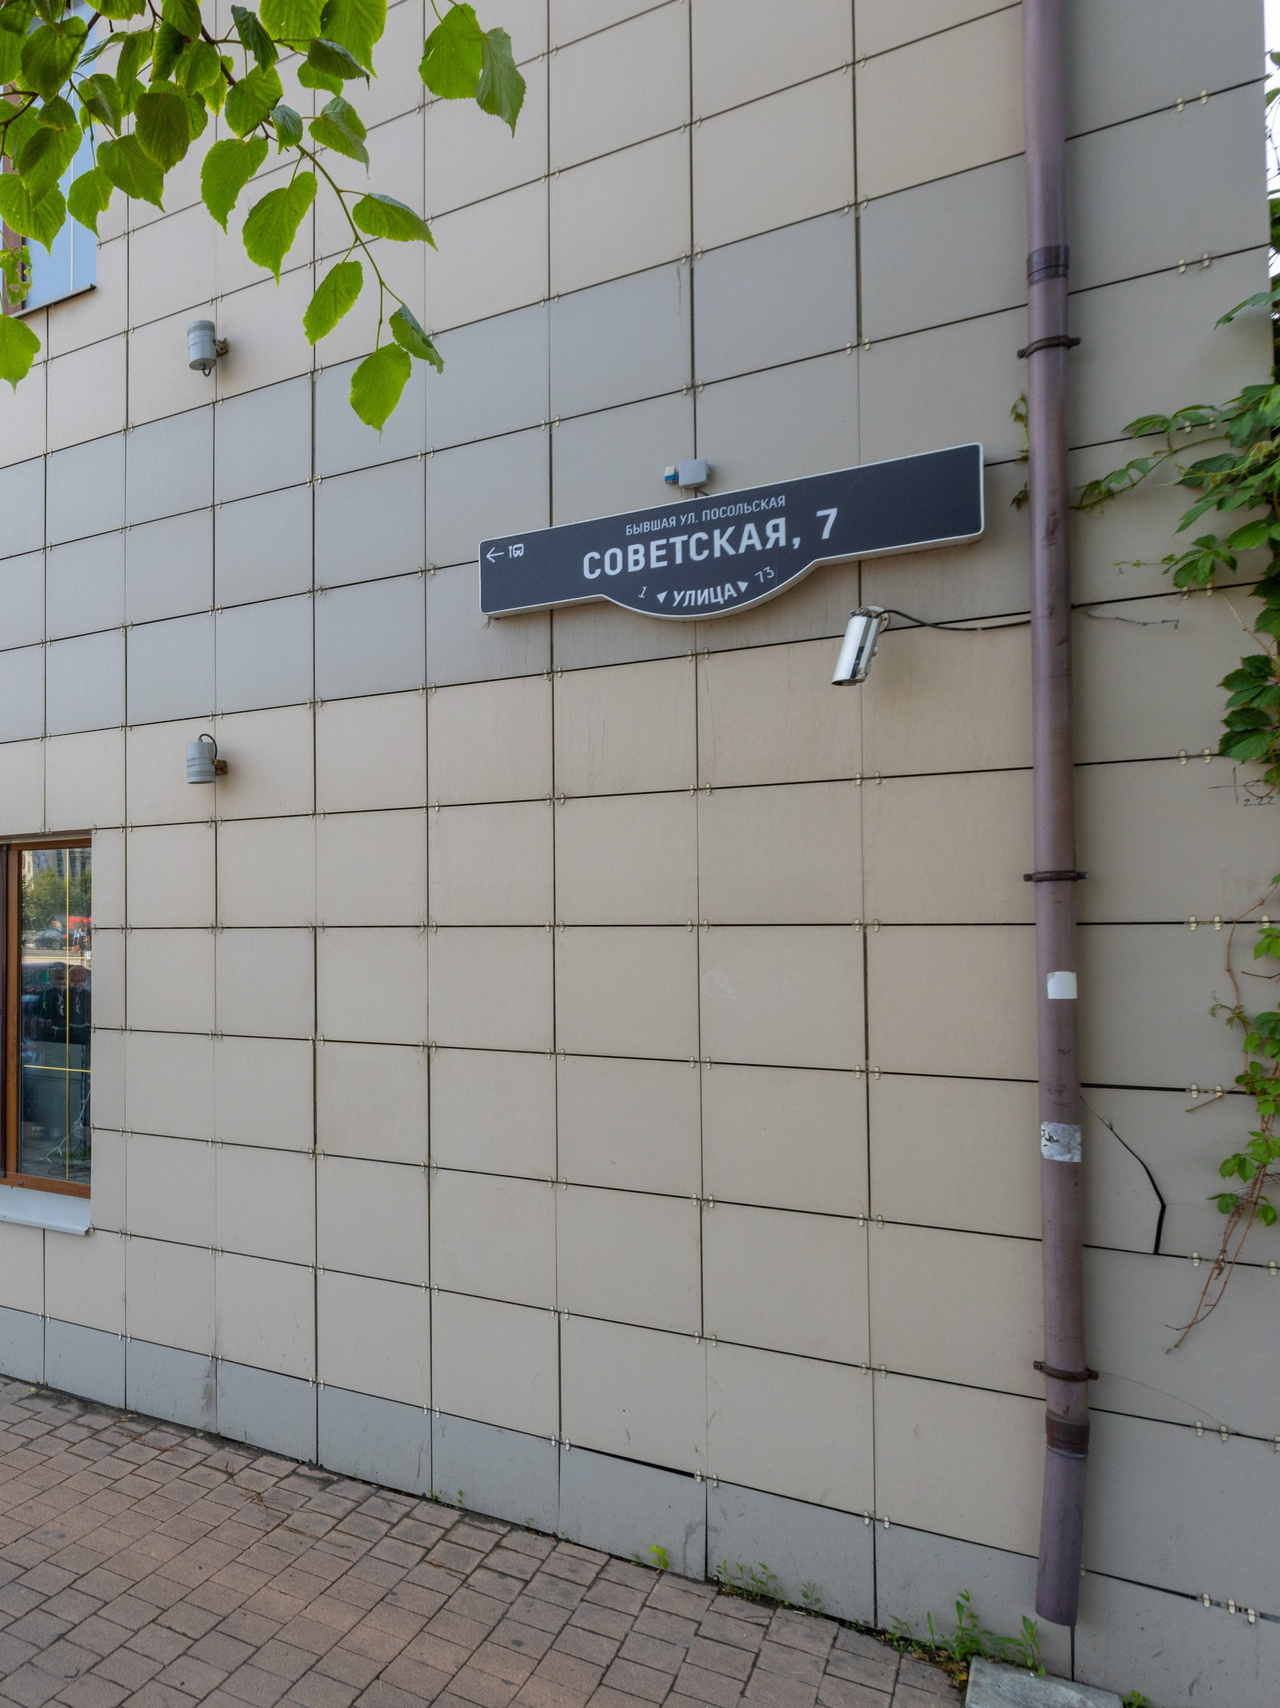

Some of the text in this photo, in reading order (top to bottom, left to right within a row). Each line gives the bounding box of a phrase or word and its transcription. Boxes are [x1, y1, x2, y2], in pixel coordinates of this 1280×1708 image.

[626, 495, 786, 536] БЫВШАЯ УЛ. ПОСОЛЬСКАЯ
[582, 507, 839, 580] СОВЕТСКАЯ, 7
[637, 565, 776, 607] 1 УЛИЦА 73
